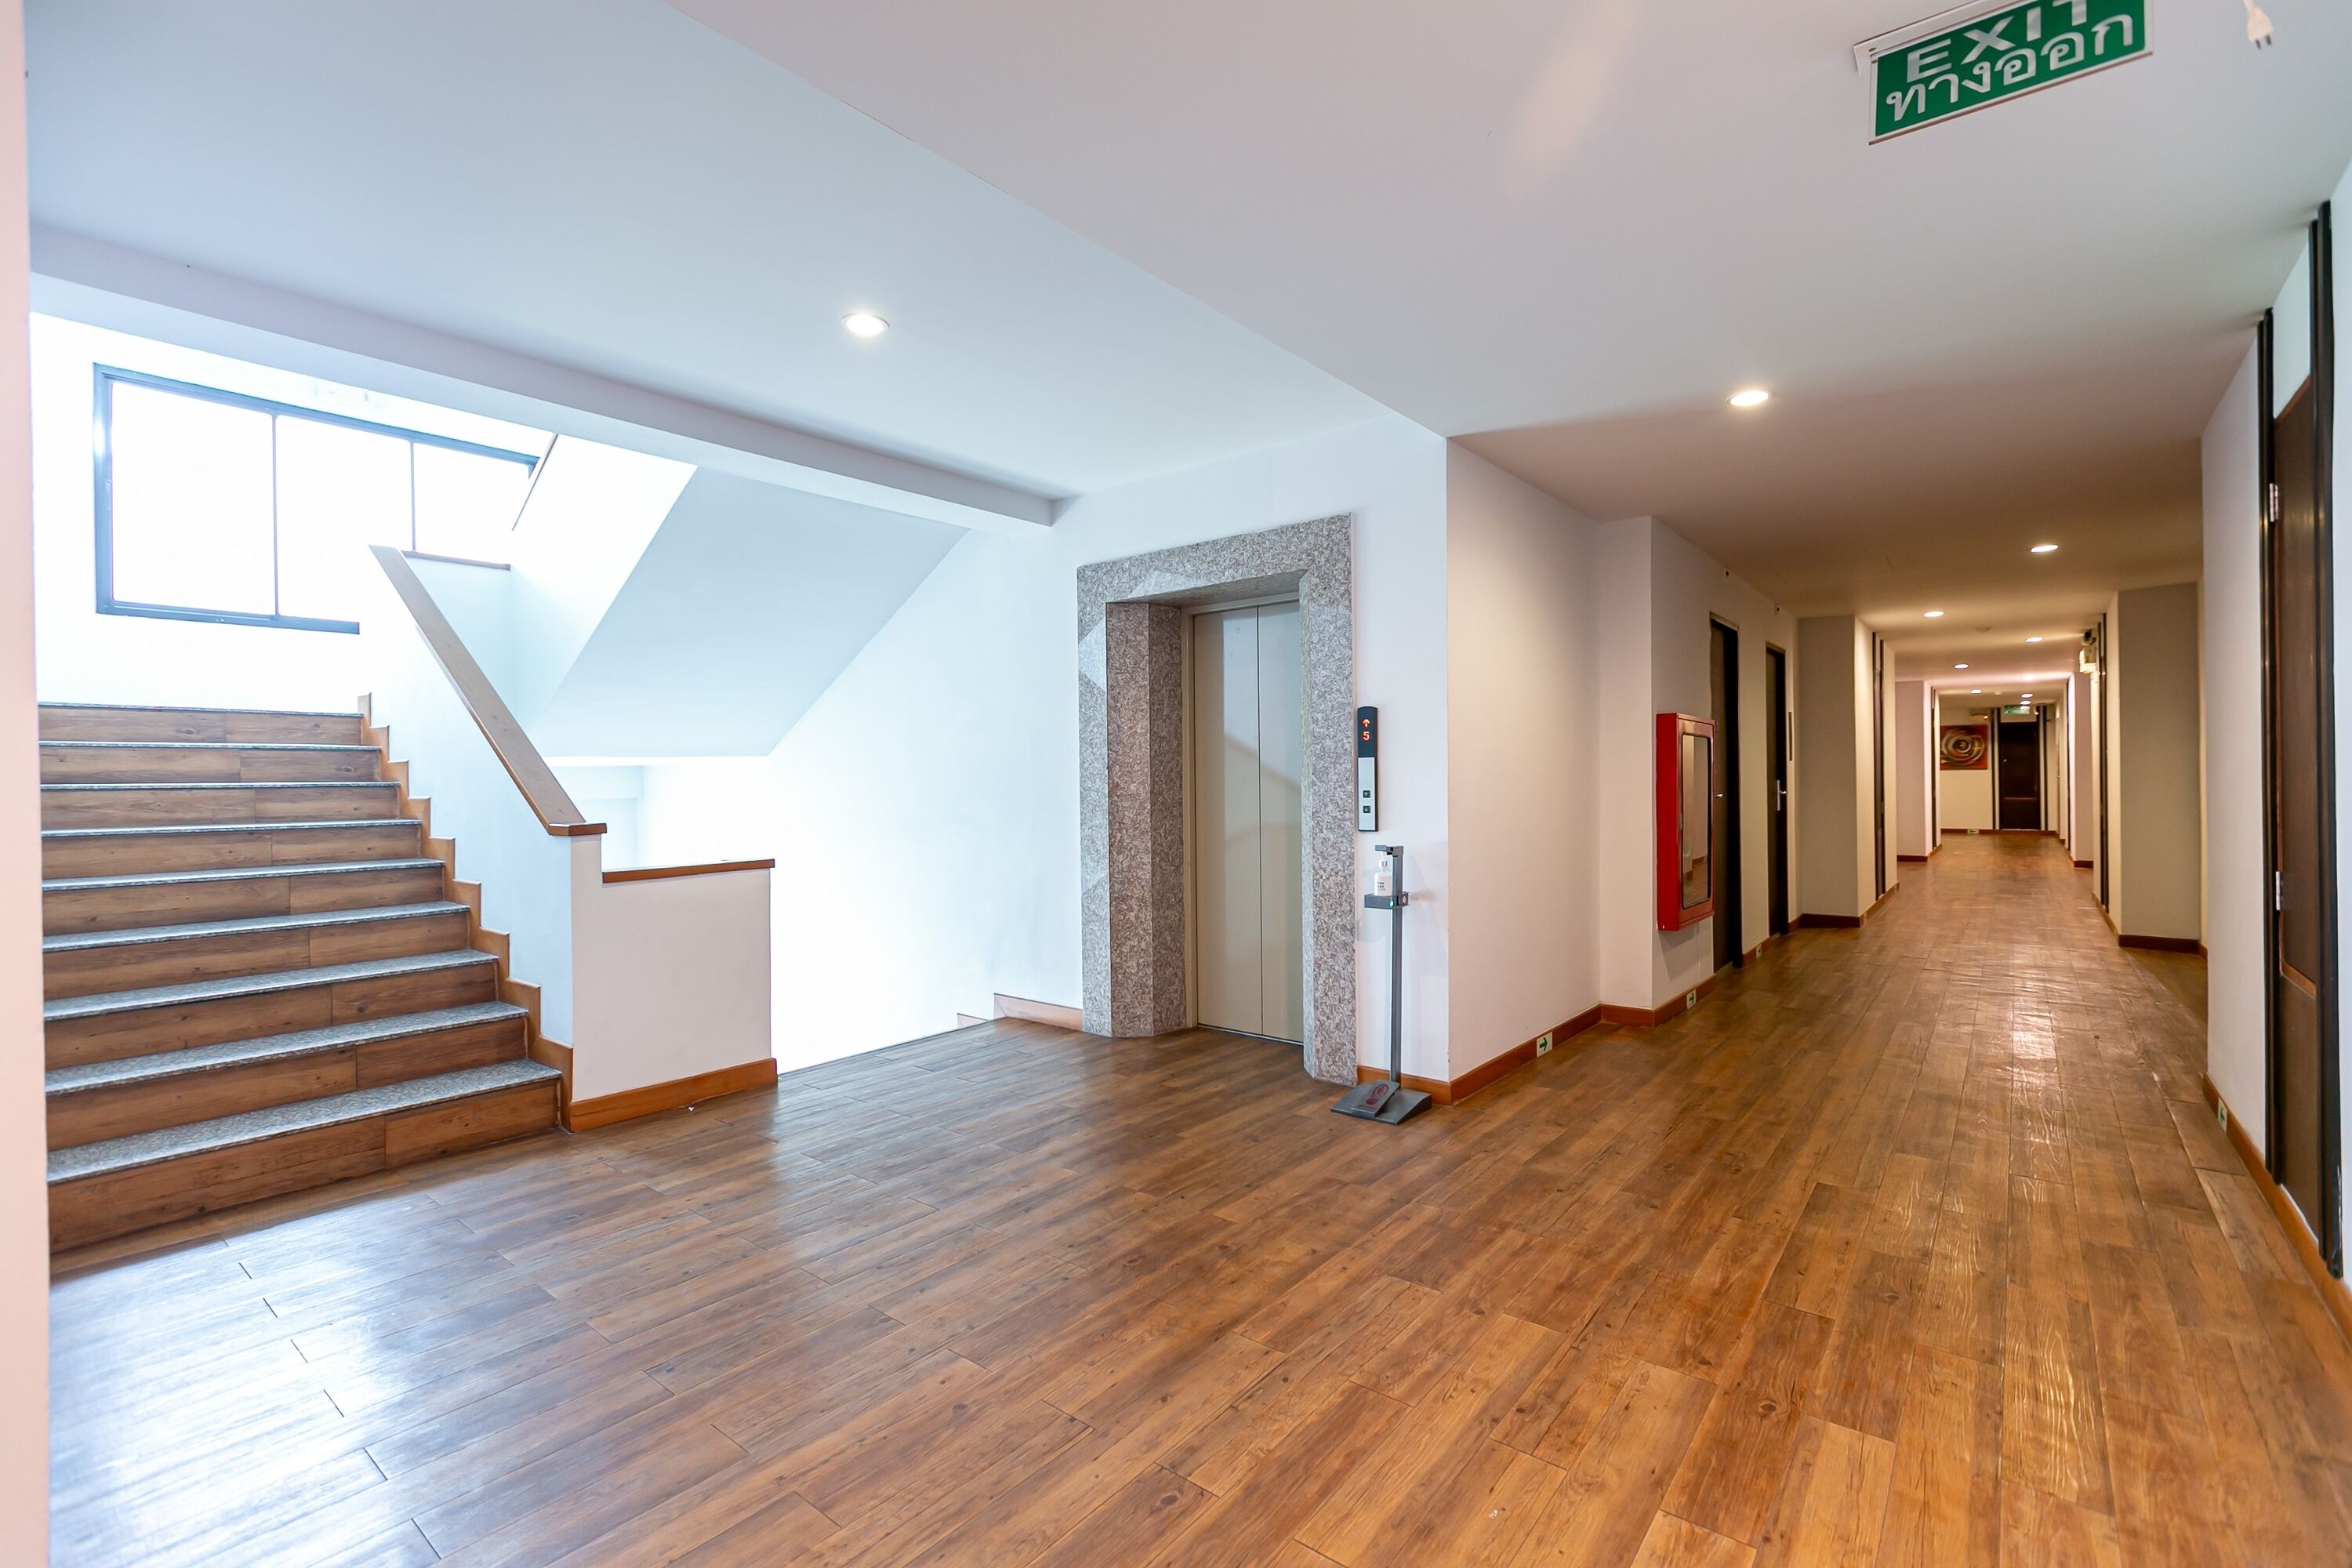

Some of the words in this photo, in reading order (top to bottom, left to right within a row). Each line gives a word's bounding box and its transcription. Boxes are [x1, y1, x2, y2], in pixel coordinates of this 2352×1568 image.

[1886, 15, 2132, 121] ทางออก
[1907, 0, 2086, 82] EXIT
[1363, 731, 1370, 741] 5
